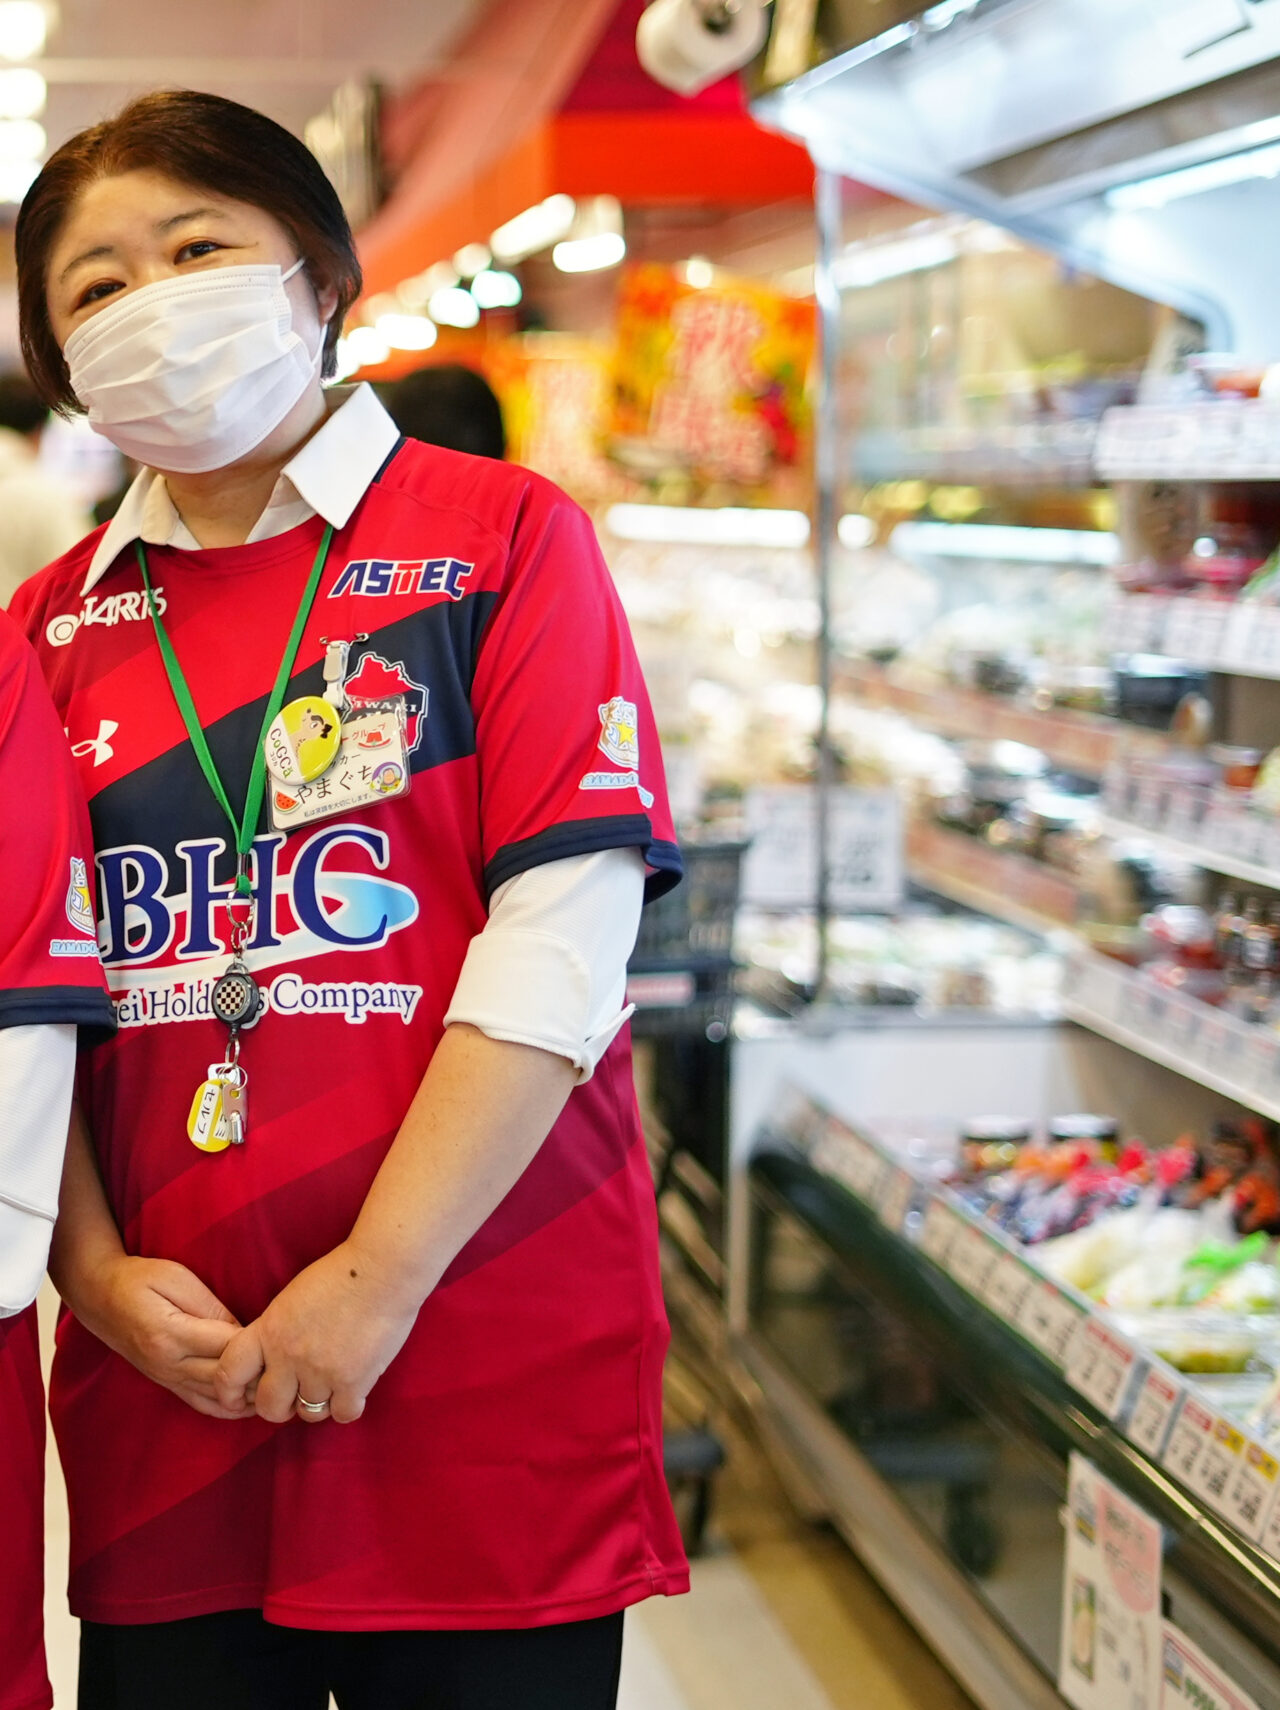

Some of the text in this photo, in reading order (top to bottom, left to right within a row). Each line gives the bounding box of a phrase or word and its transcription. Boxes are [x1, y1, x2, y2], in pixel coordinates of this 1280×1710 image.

[327, 557, 475, 601] ASTEC
[98, 826, 388, 963] BHC
[149, 983, 266, 1020] Holds
[273, 978, 418, 1019] Company
